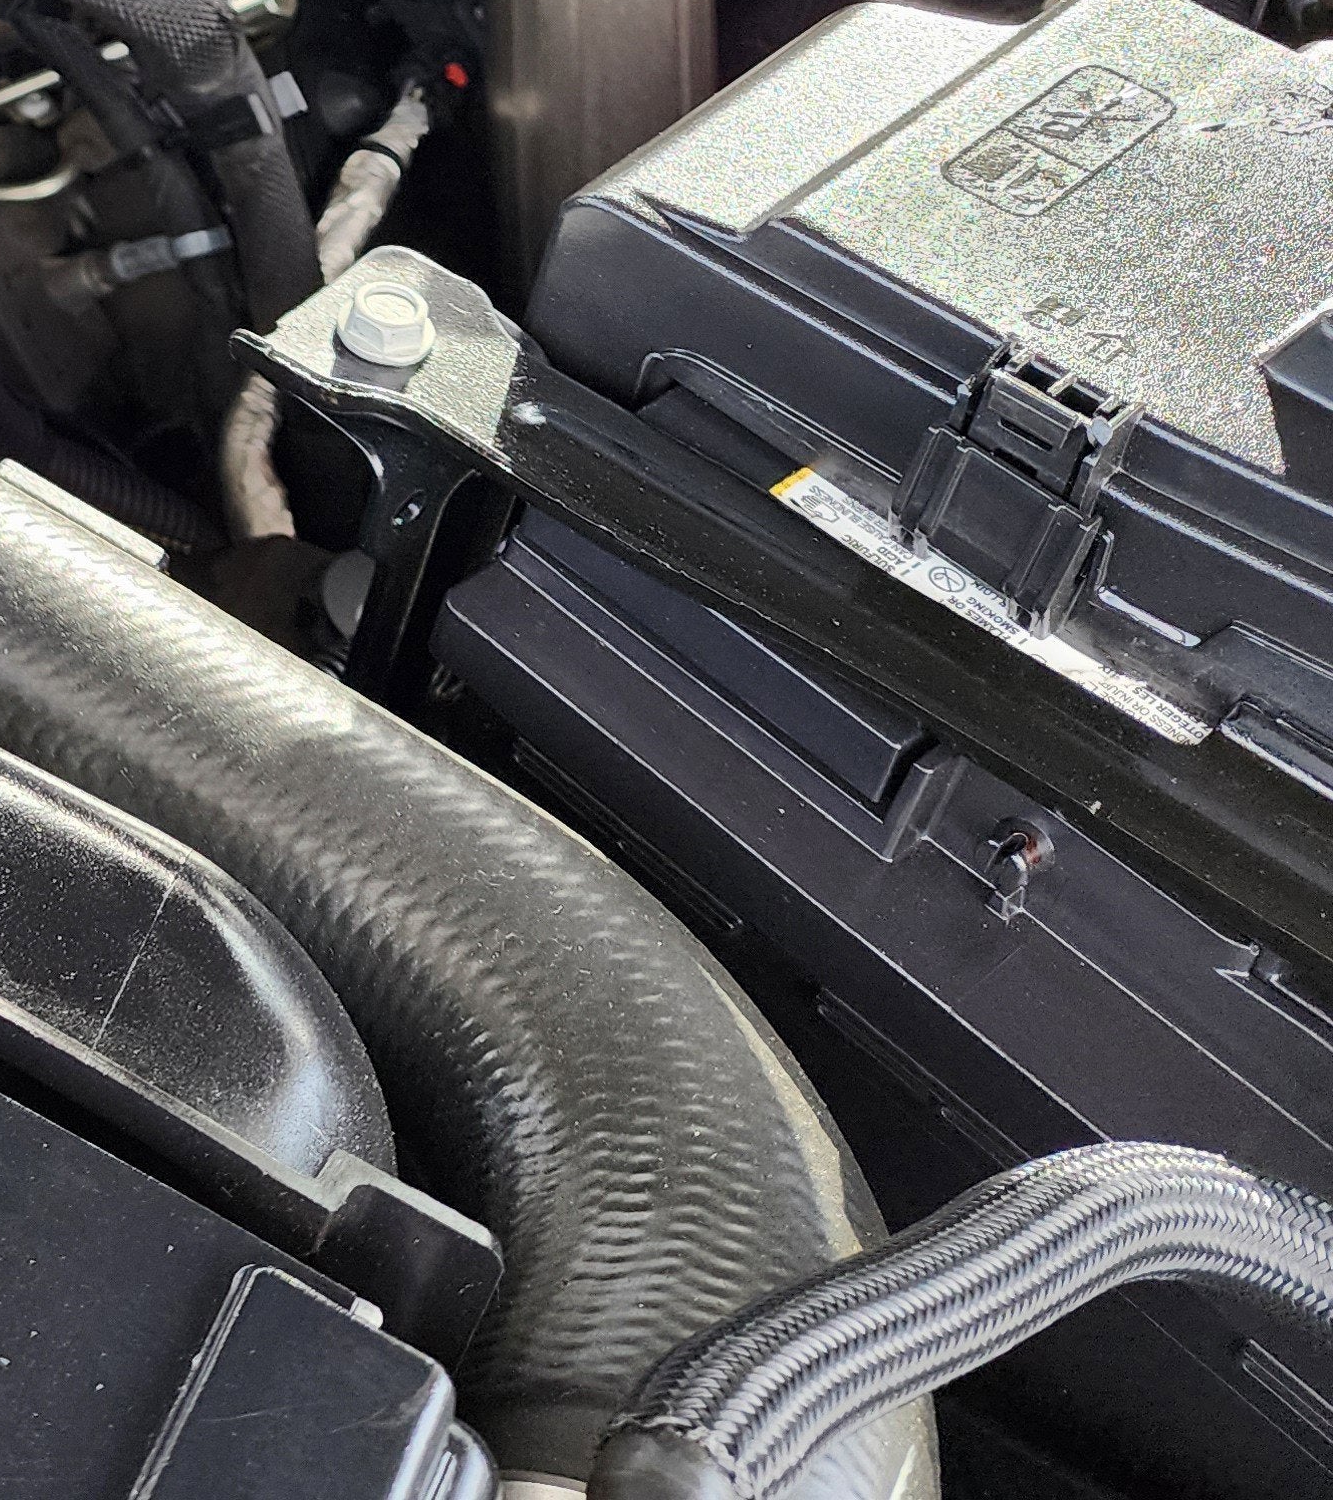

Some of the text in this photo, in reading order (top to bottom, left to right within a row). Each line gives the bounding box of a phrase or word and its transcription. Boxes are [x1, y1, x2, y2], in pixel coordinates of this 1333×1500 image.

[808, 485, 862, 523] BLINDNESS
[840, 534, 896, 573] SULFURIC
[876, 546, 906, 565] ACID
[946, 595, 966, 610] OR
[966, 596, 1021, 635] SMOKING
